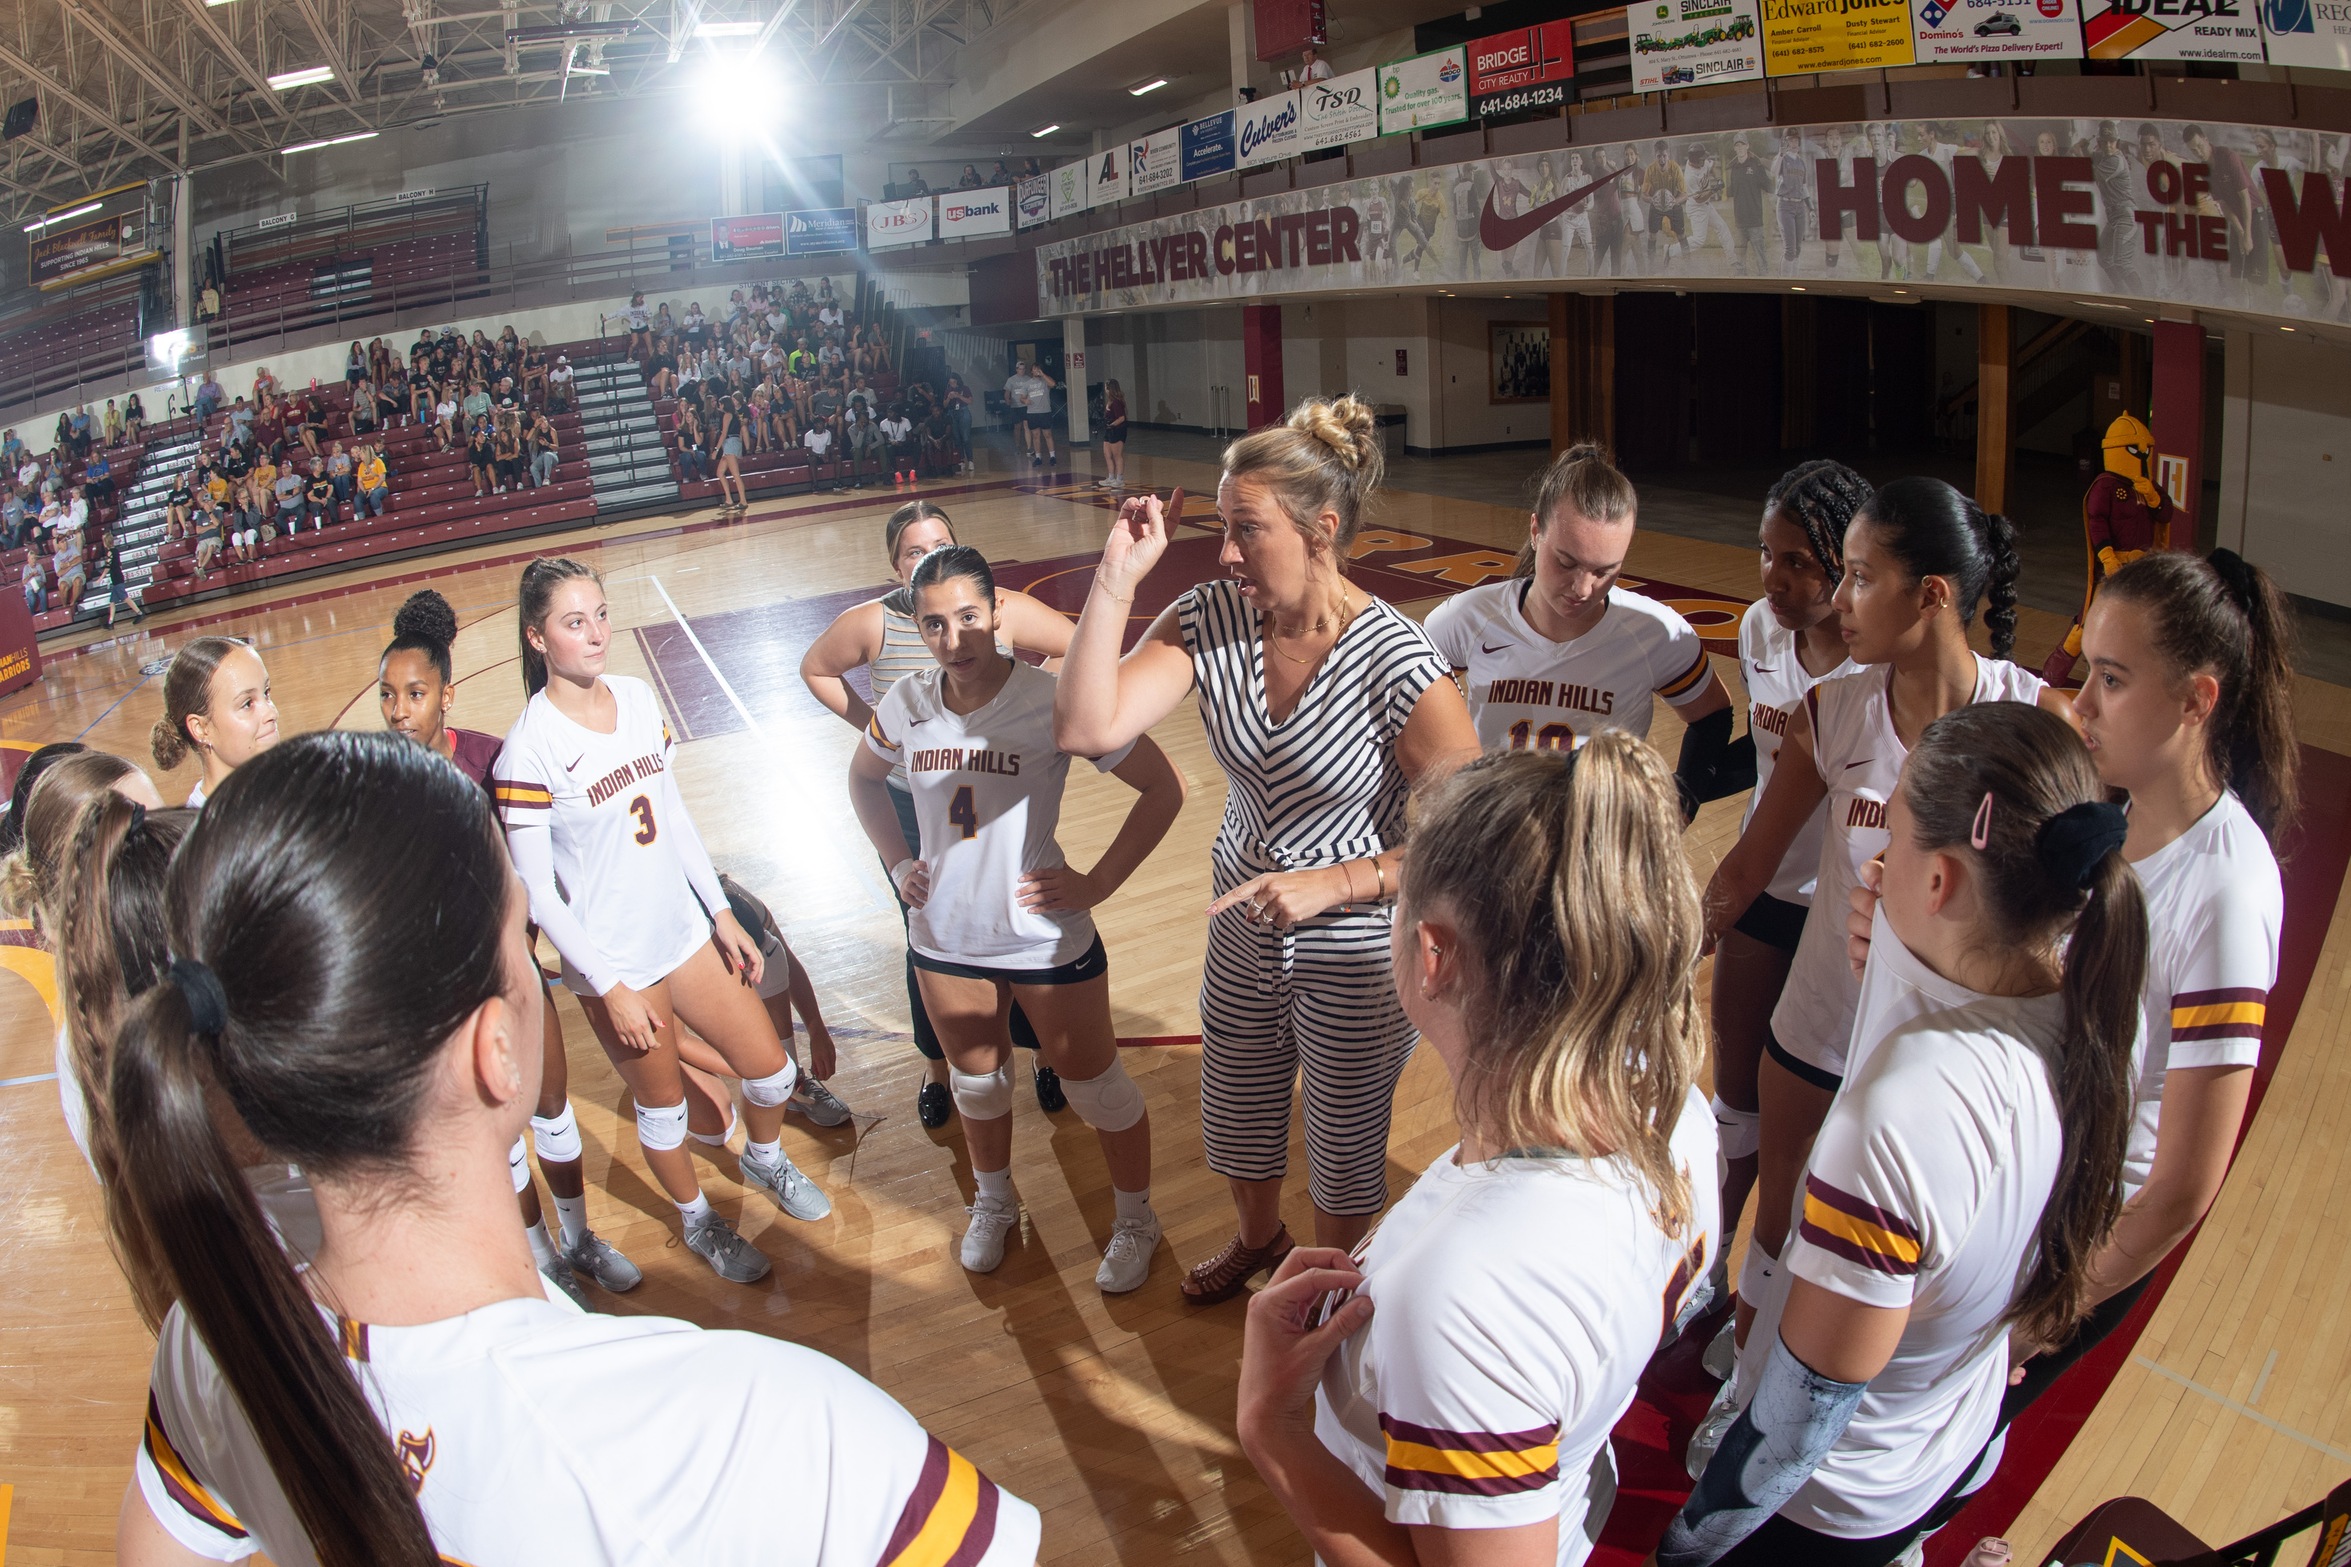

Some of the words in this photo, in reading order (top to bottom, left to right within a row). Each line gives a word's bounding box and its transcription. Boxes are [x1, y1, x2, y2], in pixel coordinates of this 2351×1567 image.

[1690, 9, 1725, 18] TRACTOR
[1764, 0, 1837, 21] Edward
[2109, 0, 2239, 17] IDEAL
[1846, 20, 1868, 29] Dusty
[1870, 16, 1900, 26] Stewart
[2333, 25, 2351, 35] HE
[1771, 29, 1794, 37] Amber
[1797, 25, 1822, 34] Carroll
[1919, 28, 1964, 40] Domino's
[2194, 26, 2232, 37] READY
[2235, 28, 2257, 38] MIX
[1848, 42, 1867, 50] (641)
[1869, 38, 1904, 48] 682-2600
[1934, 46, 1948, 54] The
[1950, 44, 1979, 54] World's
[1981, 44, 2000, 52] Pizza
[2002, 43, 2034, 53] Delivery
[2035, 42, 2063, 52] Expert!
[1477, 46, 1528, 71] BRIDGE
[1772, 49, 1790, 58] (641)
[1792, 46, 1825, 56] 682-8575
[2179, 49, 2261, 60] www.idealrm.com
[1392, 66, 1400, 74] bp
[1696, 58, 1744, 74] SINCLAIR
[1797, 56, 1882, 70] www.edwardjones.com
[1440, 68, 1461, 77] AMOCO
[1478, 78, 1496, 90] CITY
[1499, 71, 1529, 86] REALTY
[1640, 77, 1659, 86] STIHL
[1316, 86, 1362, 112] TSD
[1404, 89, 1426, 100] Quality
[1427, 87, 1440, 96] gas.
[1480, 86, 1564, 114] 641-684-1234
[1385, 104, 1406, 115] Trusted
[1407, 102, 1416, 110] for
[1417, 100, 1430, 108] over
[1432, 96, 1442, 105] 100
[1444, 93, 1462, 104] years.
[1200, 116, 1222, 130] BELLEVUE
[1350, 113, 1373, 122] Embroidery
[1240, 100, 1297, 158] Culver's
[1316, 130, 1362, 146] 641.682.4561
[1193, 144, 1224, 158] Accelerate.
[398, 190, 426, 200] BALCONY
[1815, 154, 2098, 250] HOME
[2146, 159, 2210, 206] OF
[262, 216, 288, 227] BALCONY
[808, 218, 844, 228] Meridian
[880, 212, 918, 228] JBS
[34, 247, 50, 263] Jack
[88, 224, 116, 242] Family
[2134, 210, 2230, 262] THE
[40, 252, 74, 269] SUPPORTING
[74, 247, 94, 257] INDIAN
[94, 242, 110, 251] HILLS
[1049, 252, 1091, 298] THE
[1093, 230, 1208, 292] HELLYER
[1214, 206, 1362, 276] CENTER
[60, 261, 76, 270] SINCE
[76, 257, 89, 266] 1965
[739, 281, 770, 289] STUDENT
[1488, 679, 1554, 706] INDIAN
[1557, 683, 1614, 716] HILLS
[1753, 702, 1792, 738] INDIA
[911, 748, 964, 773] INDIAN
[968, 749, 1020, 776] HILLS
[586, 764, 636, 808] INDIAN
[632, 753, 664, 780] HILLS
[948, 784, 980, 841] 4
[1846, 798, 1890, 830] INDI
[629, 793, 657, 848] 3
